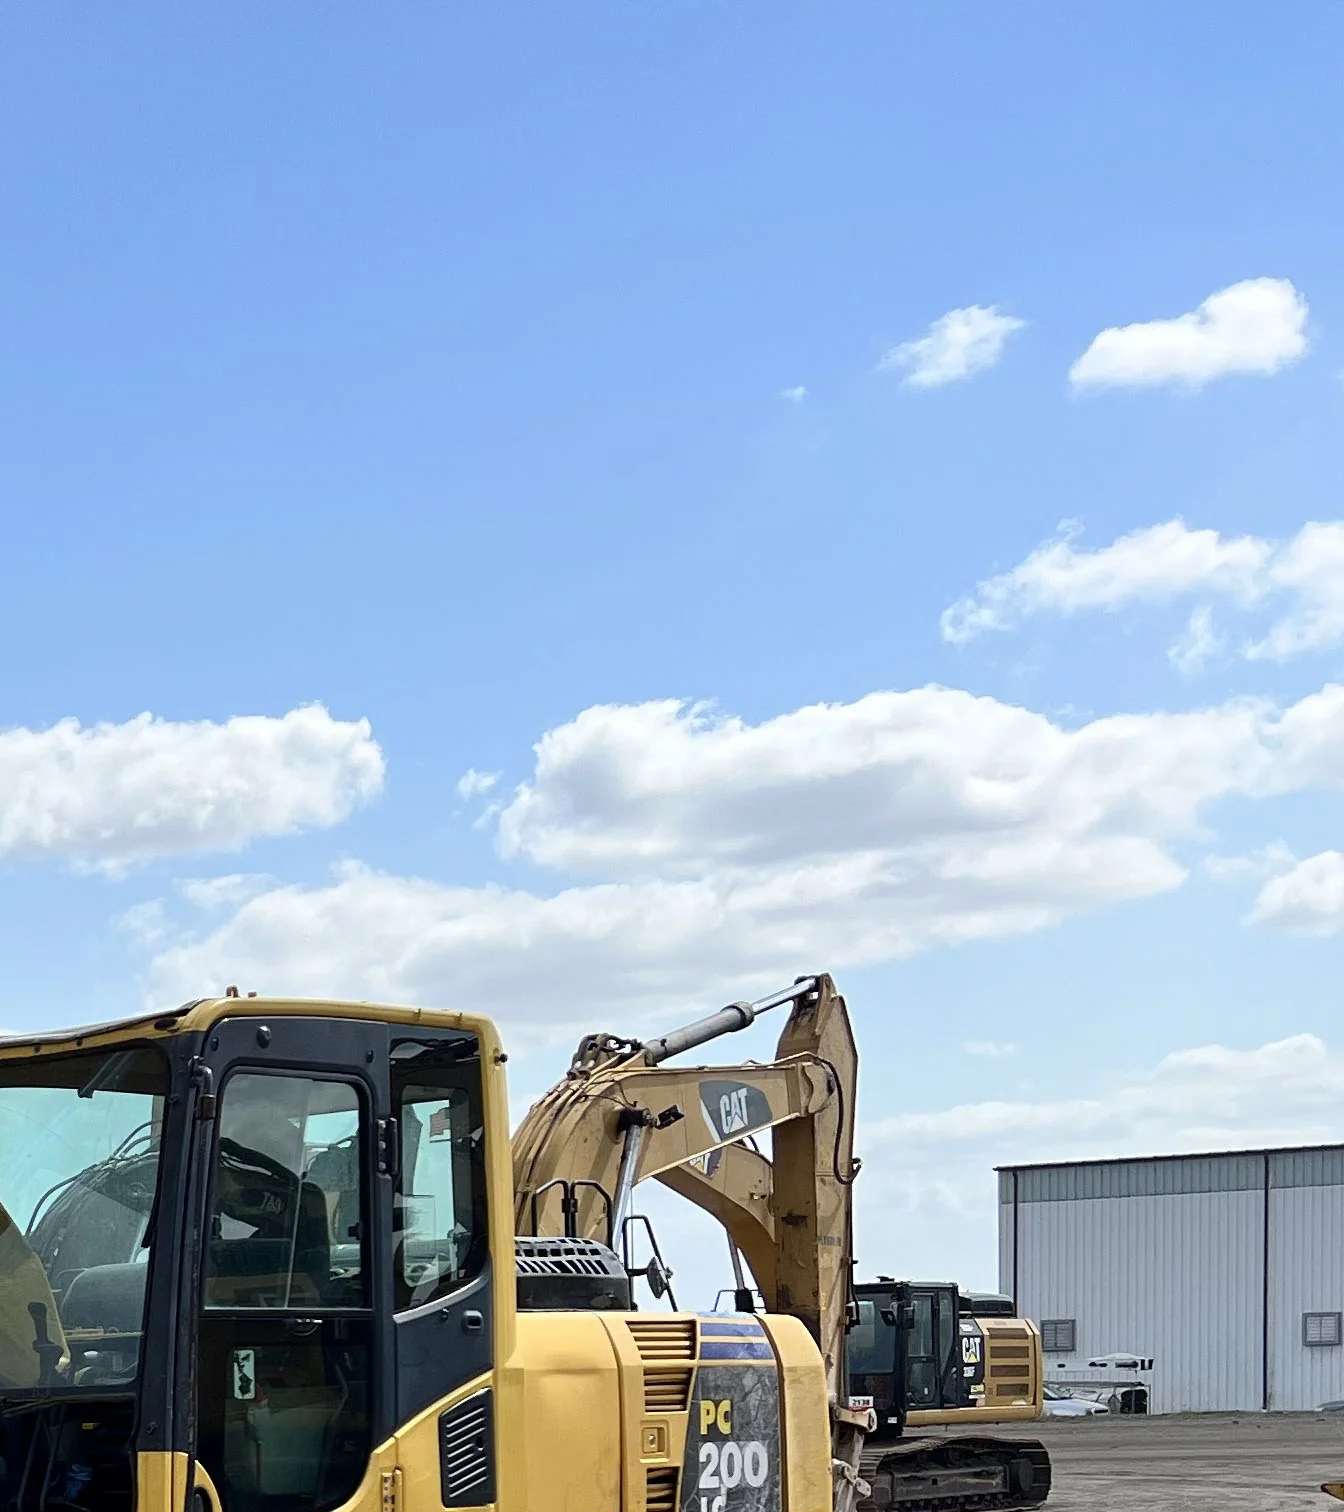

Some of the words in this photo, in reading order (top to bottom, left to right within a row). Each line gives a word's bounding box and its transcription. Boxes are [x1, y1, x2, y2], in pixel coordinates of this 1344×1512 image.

[719, 1087, 749, 1135] CAT
[962, 1337, 981, 1364] CAT
[700, 1400, 732, 1435] PC
[698, 1441, 769, 1489] 200
